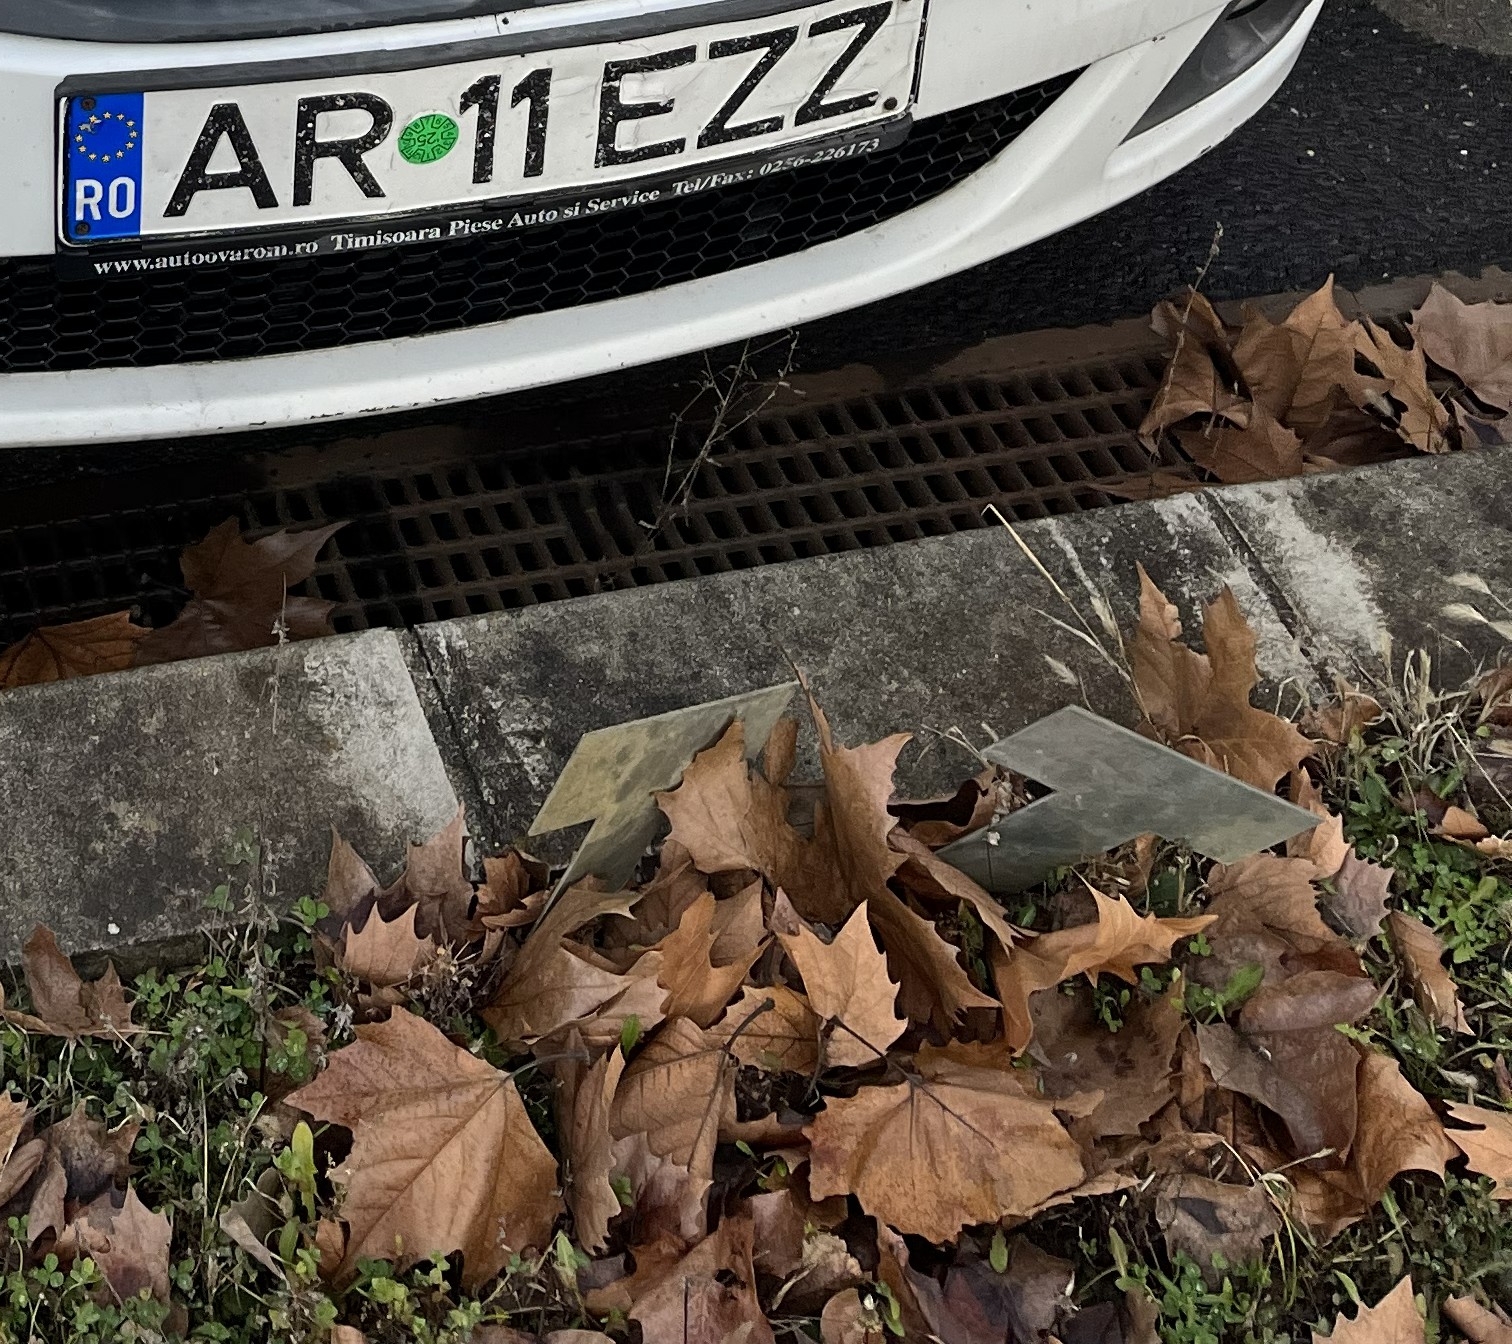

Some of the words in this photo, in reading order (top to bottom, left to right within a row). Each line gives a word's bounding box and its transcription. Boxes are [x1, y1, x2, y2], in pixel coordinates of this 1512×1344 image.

[162, 93, 393, 218] AR
[458, 67, 552, 185] 11
[594, 1, 894, 169] EZZ
[75, 176, 136, 221] RO
[330, 226, 441, 252] Timisoara
[447, 216, 503, 237] Piese
[506, 207, 558, 229] Auto
[585, 187, 660, 215] Service
[671, 168, 754, 197] Tel/Fax:
